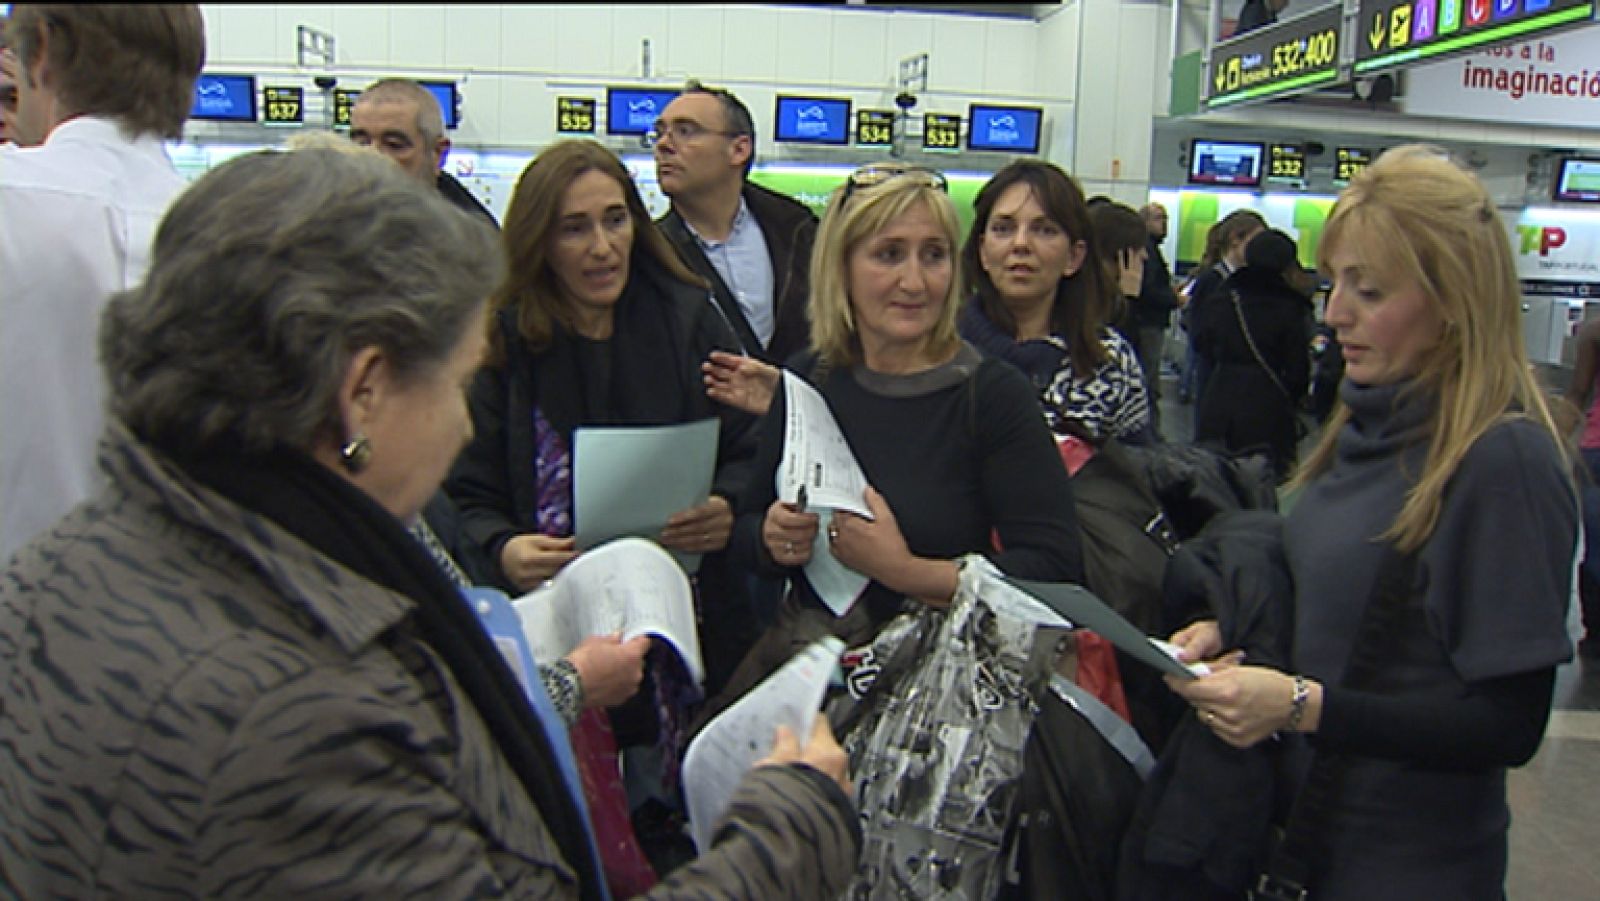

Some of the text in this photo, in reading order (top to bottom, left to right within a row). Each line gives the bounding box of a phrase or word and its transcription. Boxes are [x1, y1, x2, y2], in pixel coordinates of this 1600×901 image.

[1418, 3, 1429, 34] A
[1520, 46, 1531, 59] a
[1538, 42, 1555, 61] la
[269, 102, 299, 119] 537
[562, 113, 592, 130] 535
[860, 125, 890, 142] 534
[927, 128, 956, 146] 533
[1273, 160, 1301, 175] 532
[1515, 224, 1567, 257] TAP
